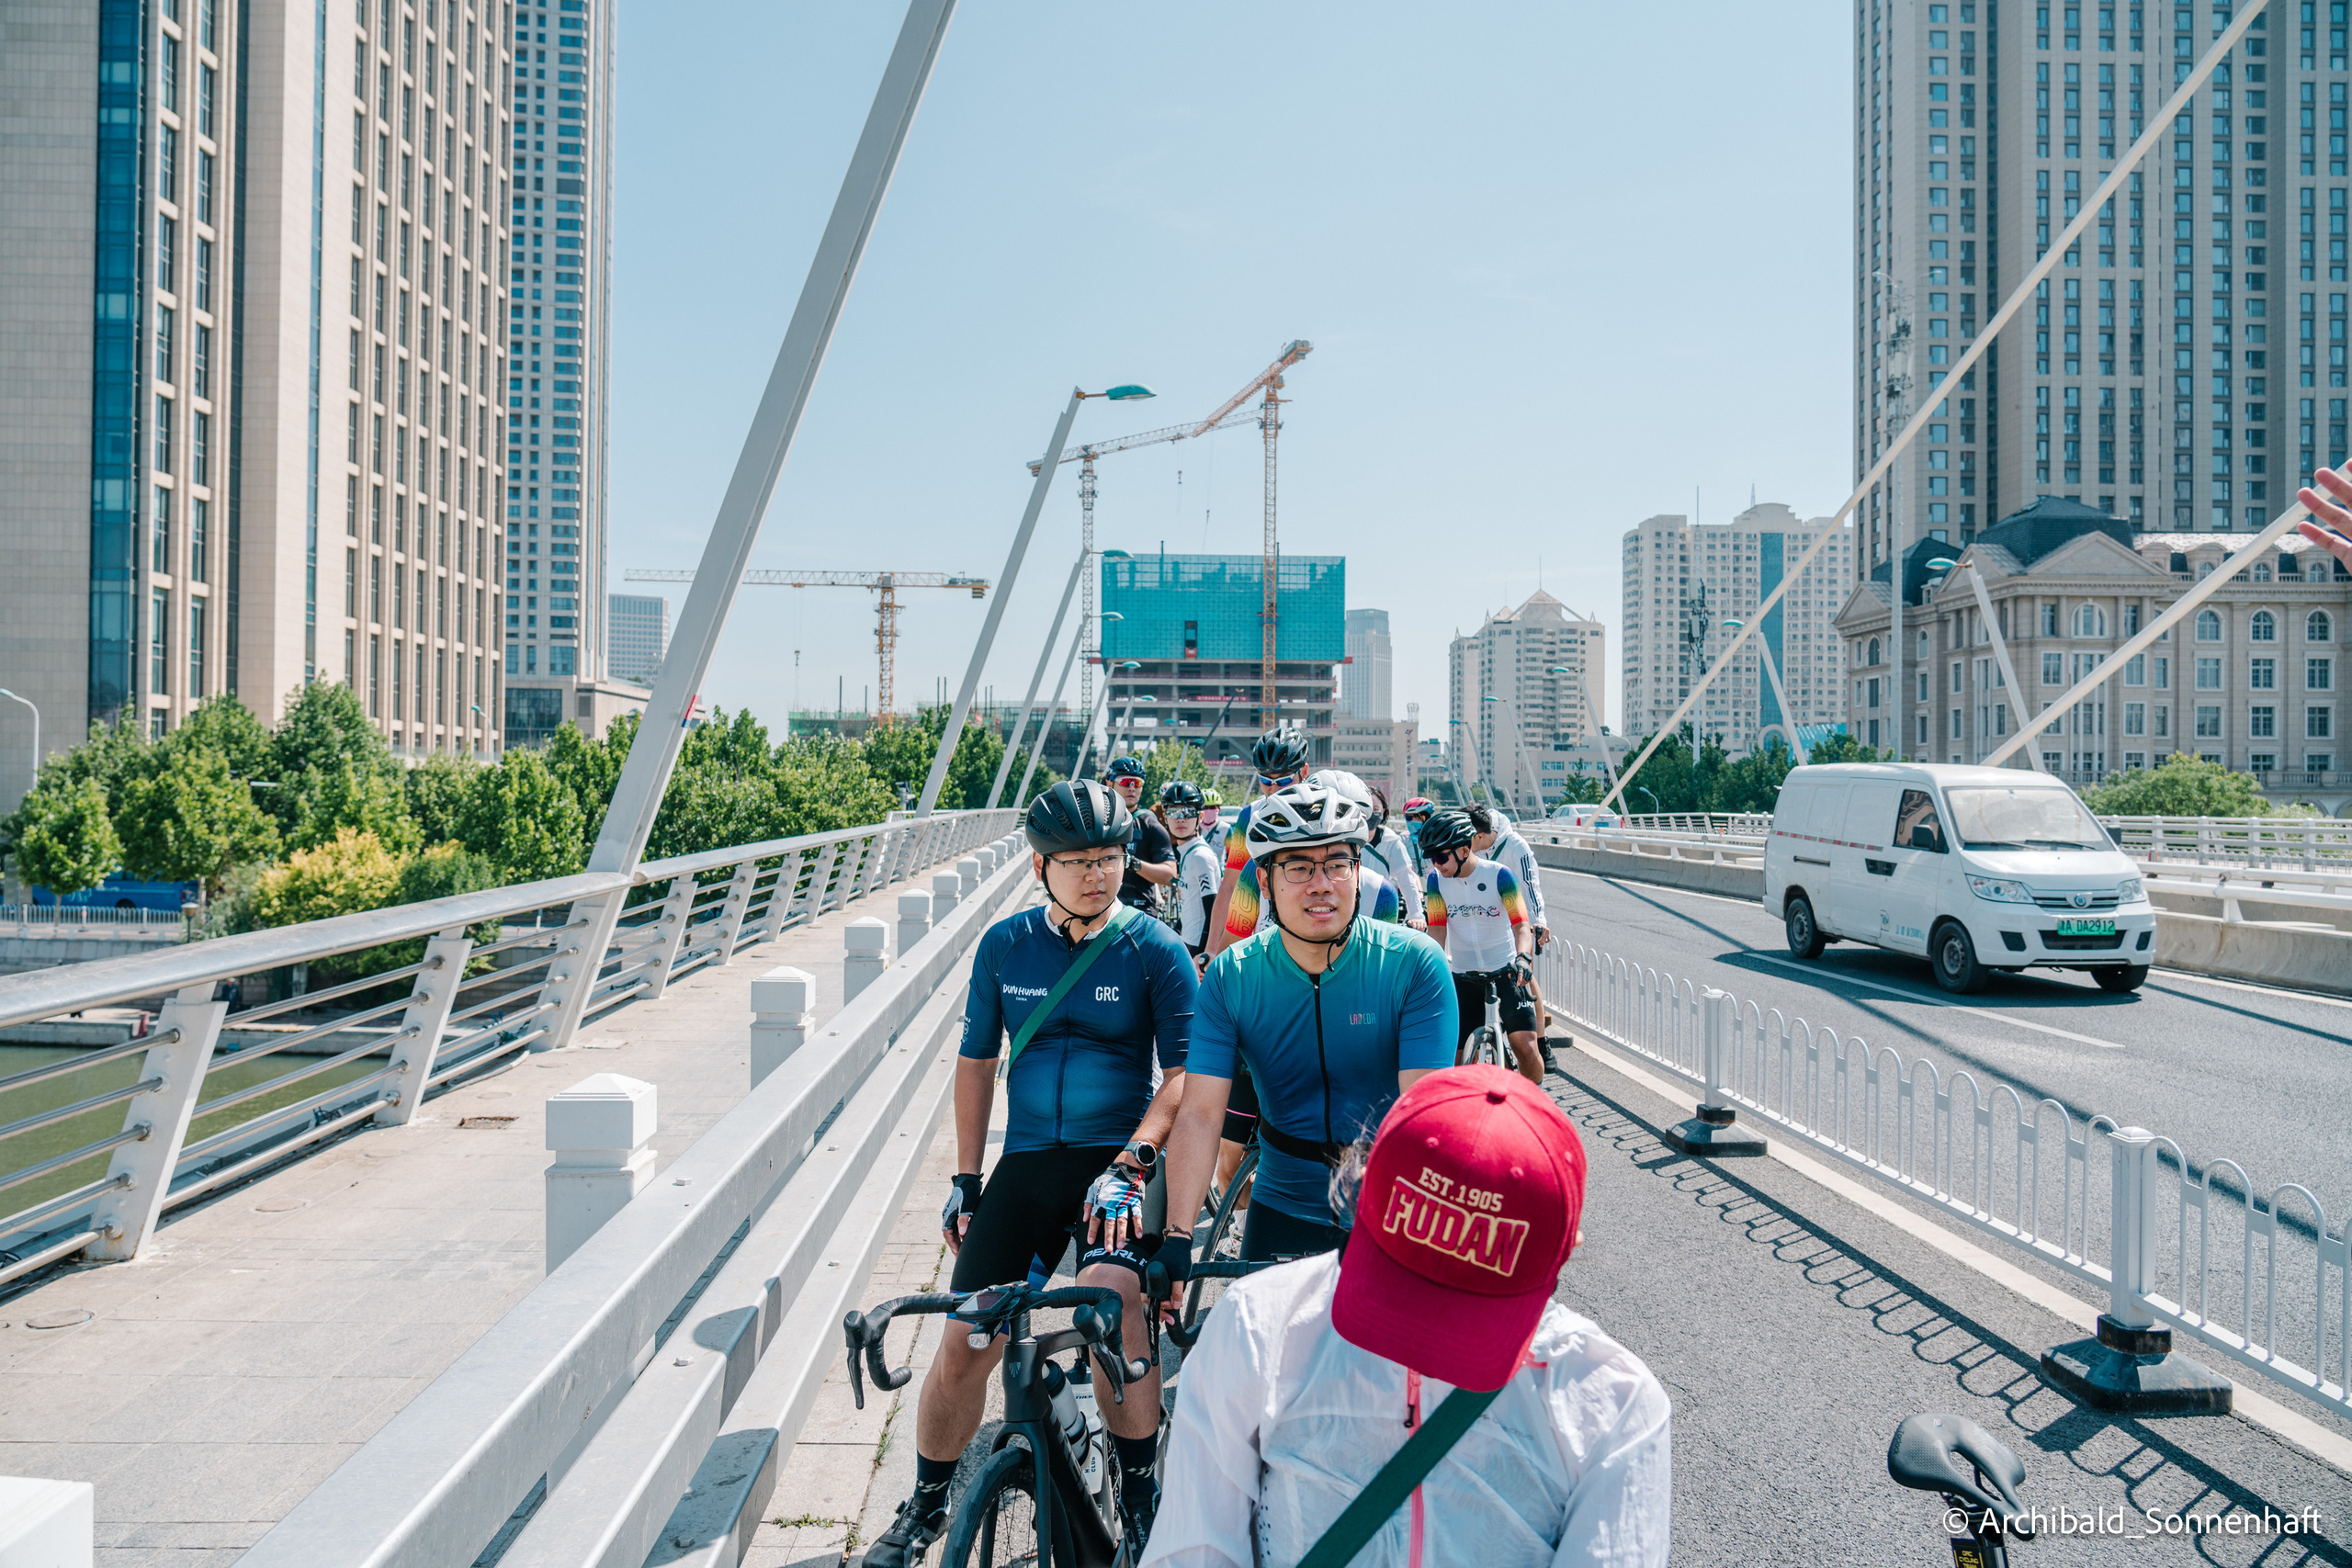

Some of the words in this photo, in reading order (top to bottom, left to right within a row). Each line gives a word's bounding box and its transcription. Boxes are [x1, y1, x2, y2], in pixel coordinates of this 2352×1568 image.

[1095, 986, 1120, 1002] GRC
[1418, 1167, 1504, 1213] EST.1905
[1383, 1176, 1531, 1278] FUDAN
